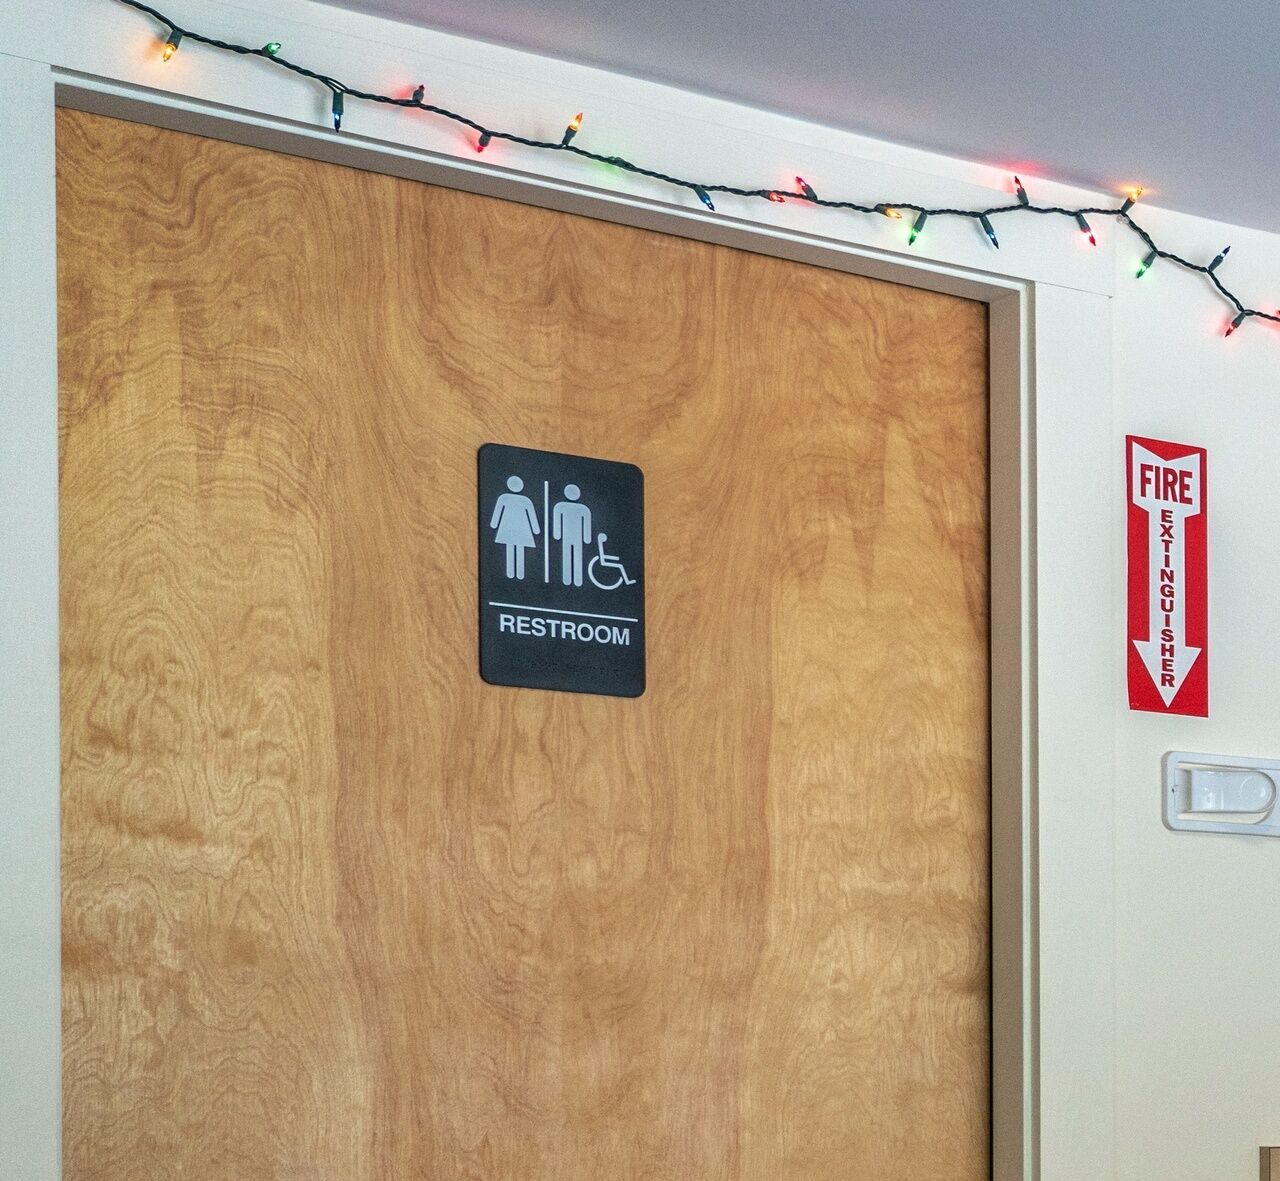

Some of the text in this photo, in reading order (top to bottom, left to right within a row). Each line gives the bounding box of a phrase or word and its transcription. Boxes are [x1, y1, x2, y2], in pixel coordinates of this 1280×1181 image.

[1140, 463, 1193, 505] FIRE
[1159, 508, 1175, 688] EXTINGUISHER
[499, 614, 630, 646] RESTROOM
